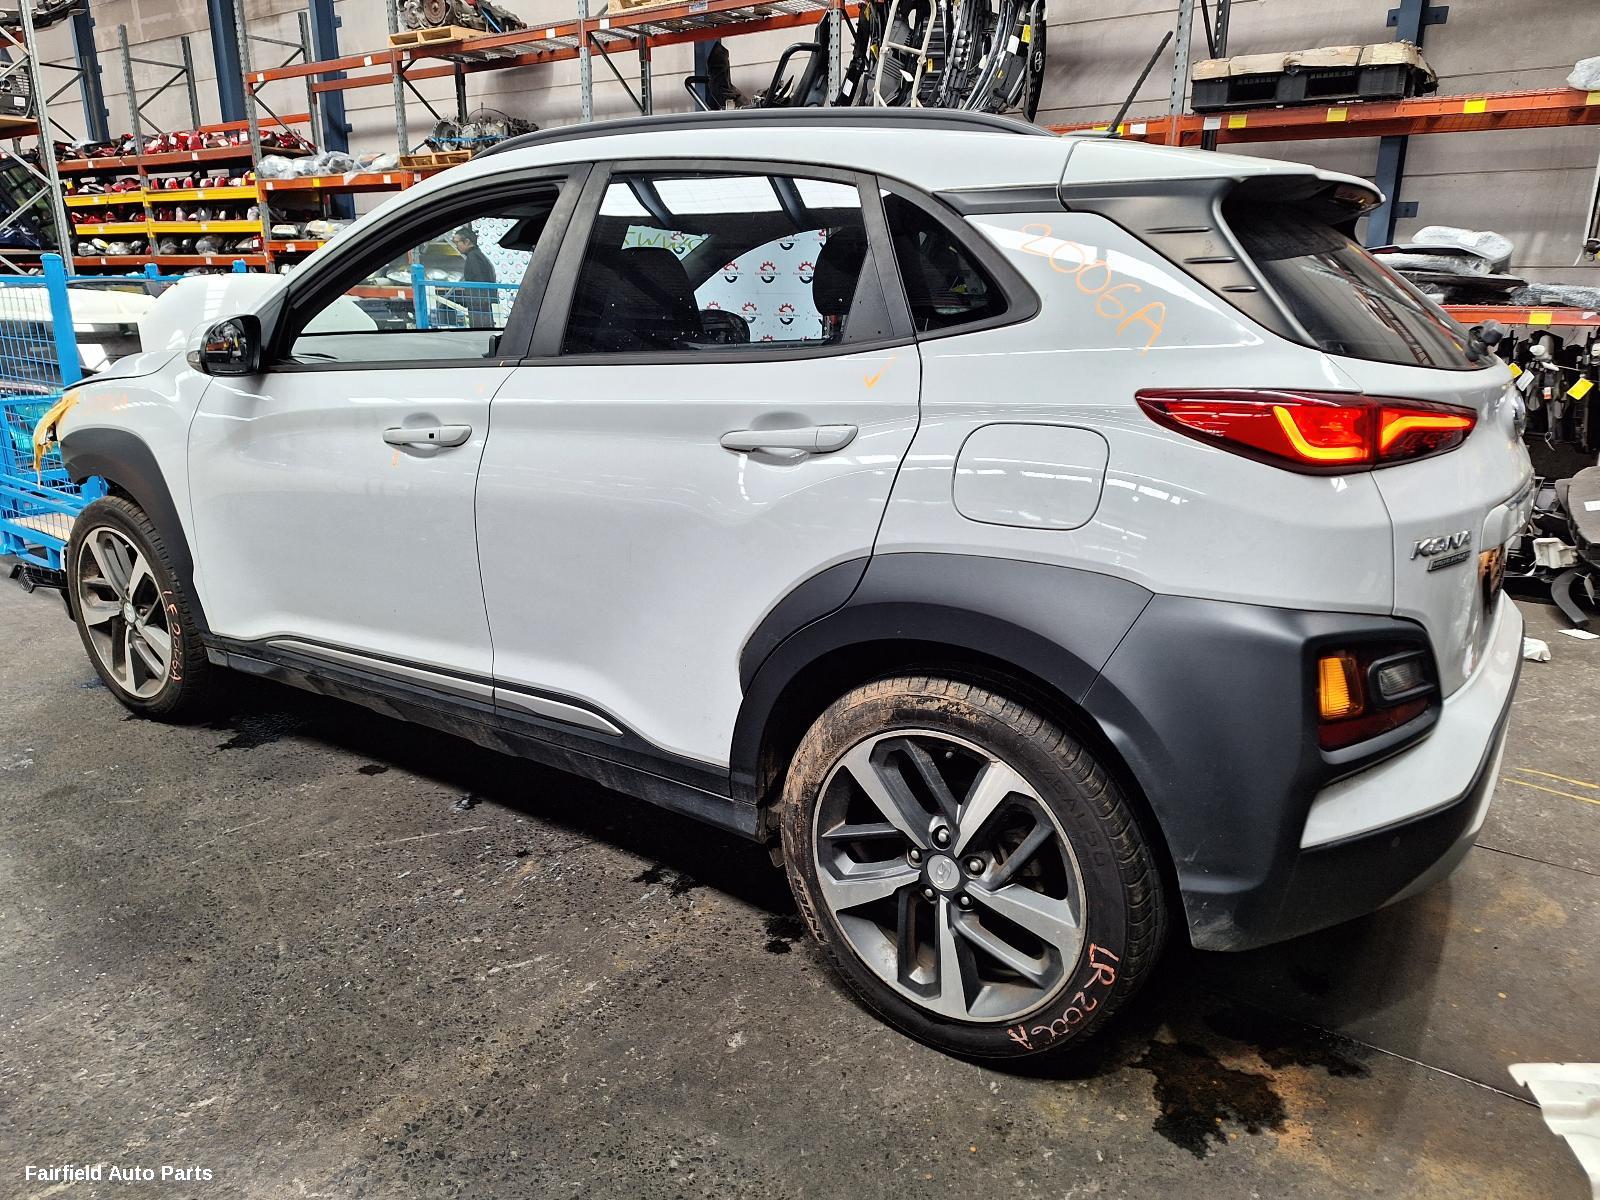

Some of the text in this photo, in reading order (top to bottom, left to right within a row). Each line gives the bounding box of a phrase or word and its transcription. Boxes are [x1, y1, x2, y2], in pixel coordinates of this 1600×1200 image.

[1020, 223, 1166, 357] 2006A
[1410, 530, 1472, 560] KONA
[1088, 942, 1119, 988] LR
